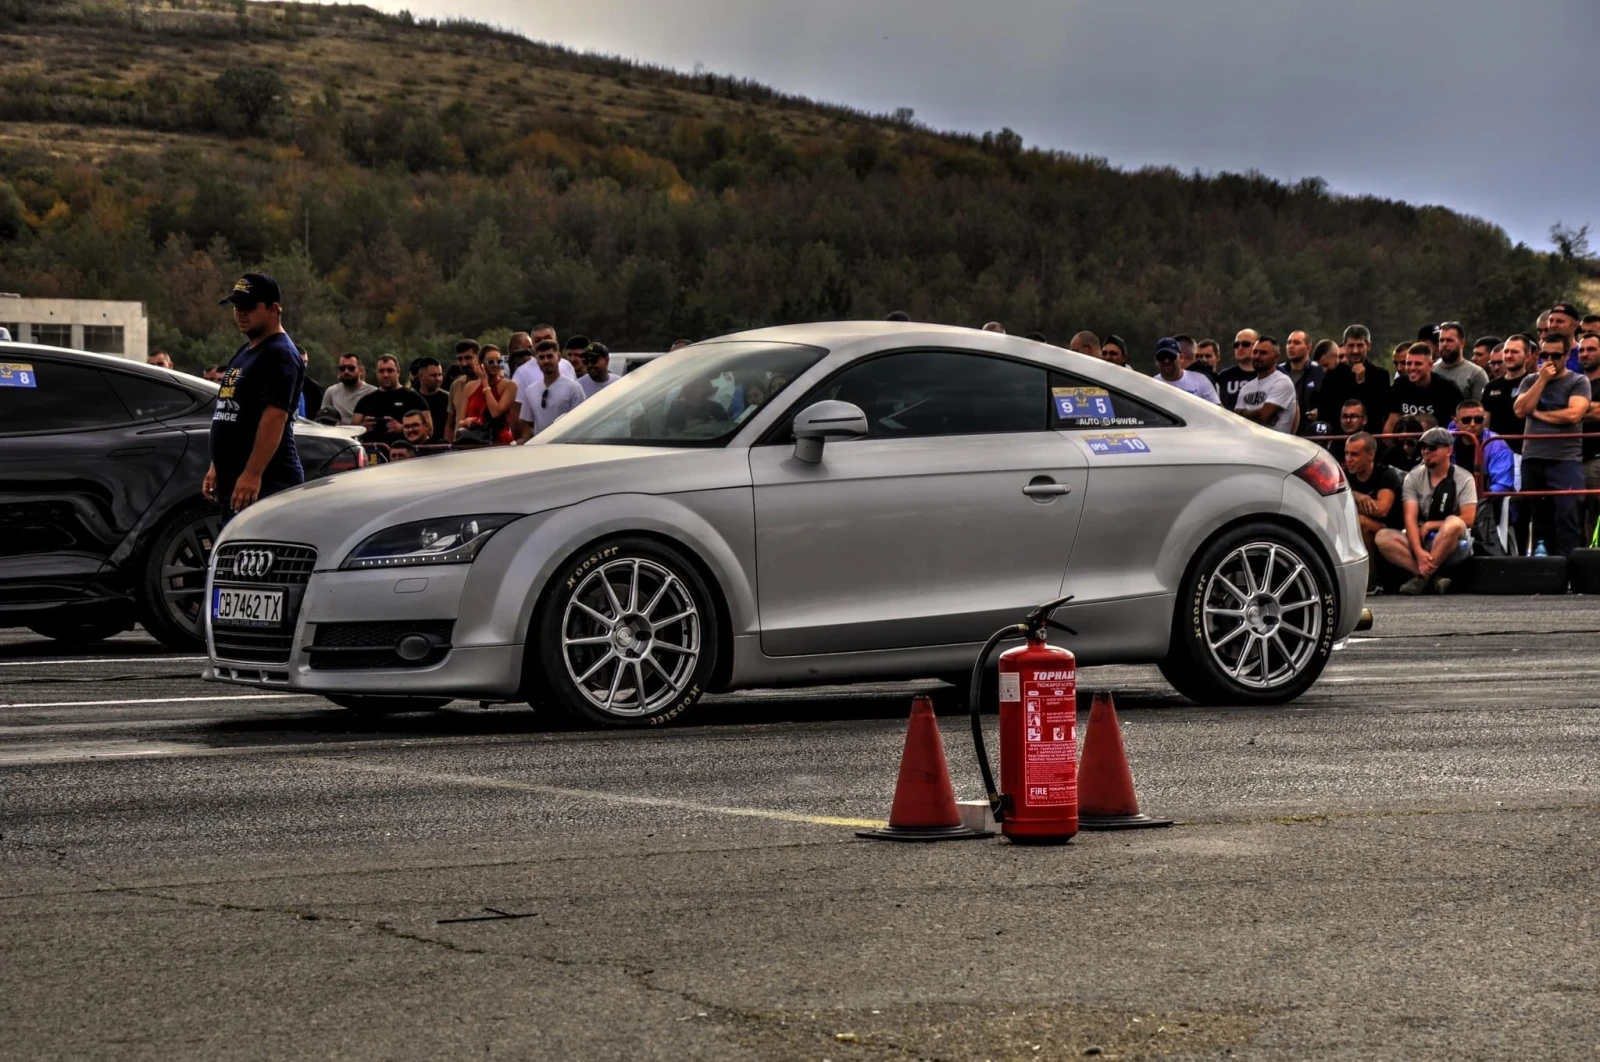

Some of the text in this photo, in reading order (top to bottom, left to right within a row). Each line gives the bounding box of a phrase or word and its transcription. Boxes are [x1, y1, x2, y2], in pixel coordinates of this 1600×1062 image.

[20, 371, 30, 385] 8
[1061, 402, 1074, 414] 9
[1095, 398, 1107, 414] 5
[1402, 403, 1435, 415] BOSS
[1079, 417, 1100, 425] AUTO
[1111, 417, 1138, 425] POWER
[1123, 438, 1146, 450] 10
[232, 593, 261, 619] 7462
[264, 594, 281, 621] TX
